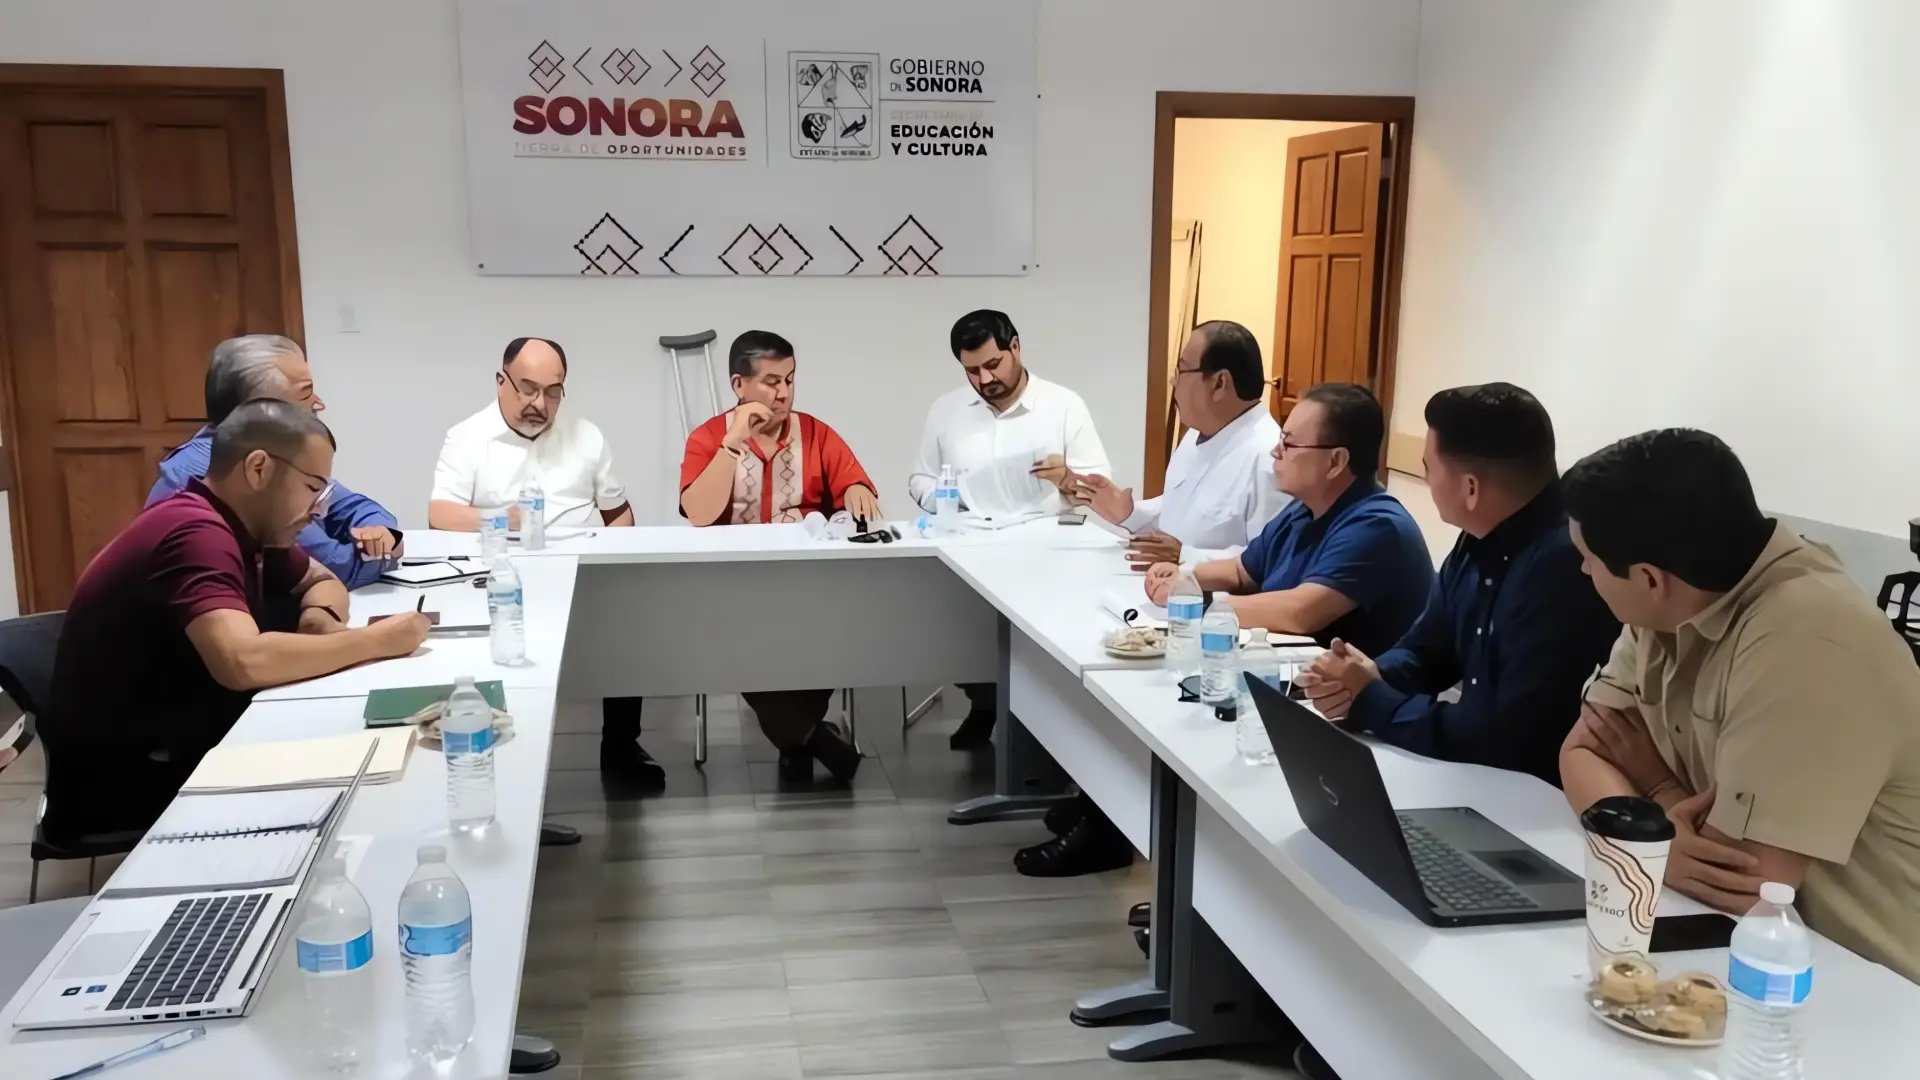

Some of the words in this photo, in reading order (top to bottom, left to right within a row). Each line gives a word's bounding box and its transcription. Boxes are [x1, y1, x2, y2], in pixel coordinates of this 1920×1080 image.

[890, 58, 985, 76] GOBIERNO
[905, 77, 983, 93] SONORA
[513, 95, 745, 138] SONORA
[890, 122, 994, 139] EDUCACIÓN
[607, 144, 747, 156] OPORTUNIDADES
[891, 143, 902, 156] Y
[907, 143, 988, 156] CULTURA
